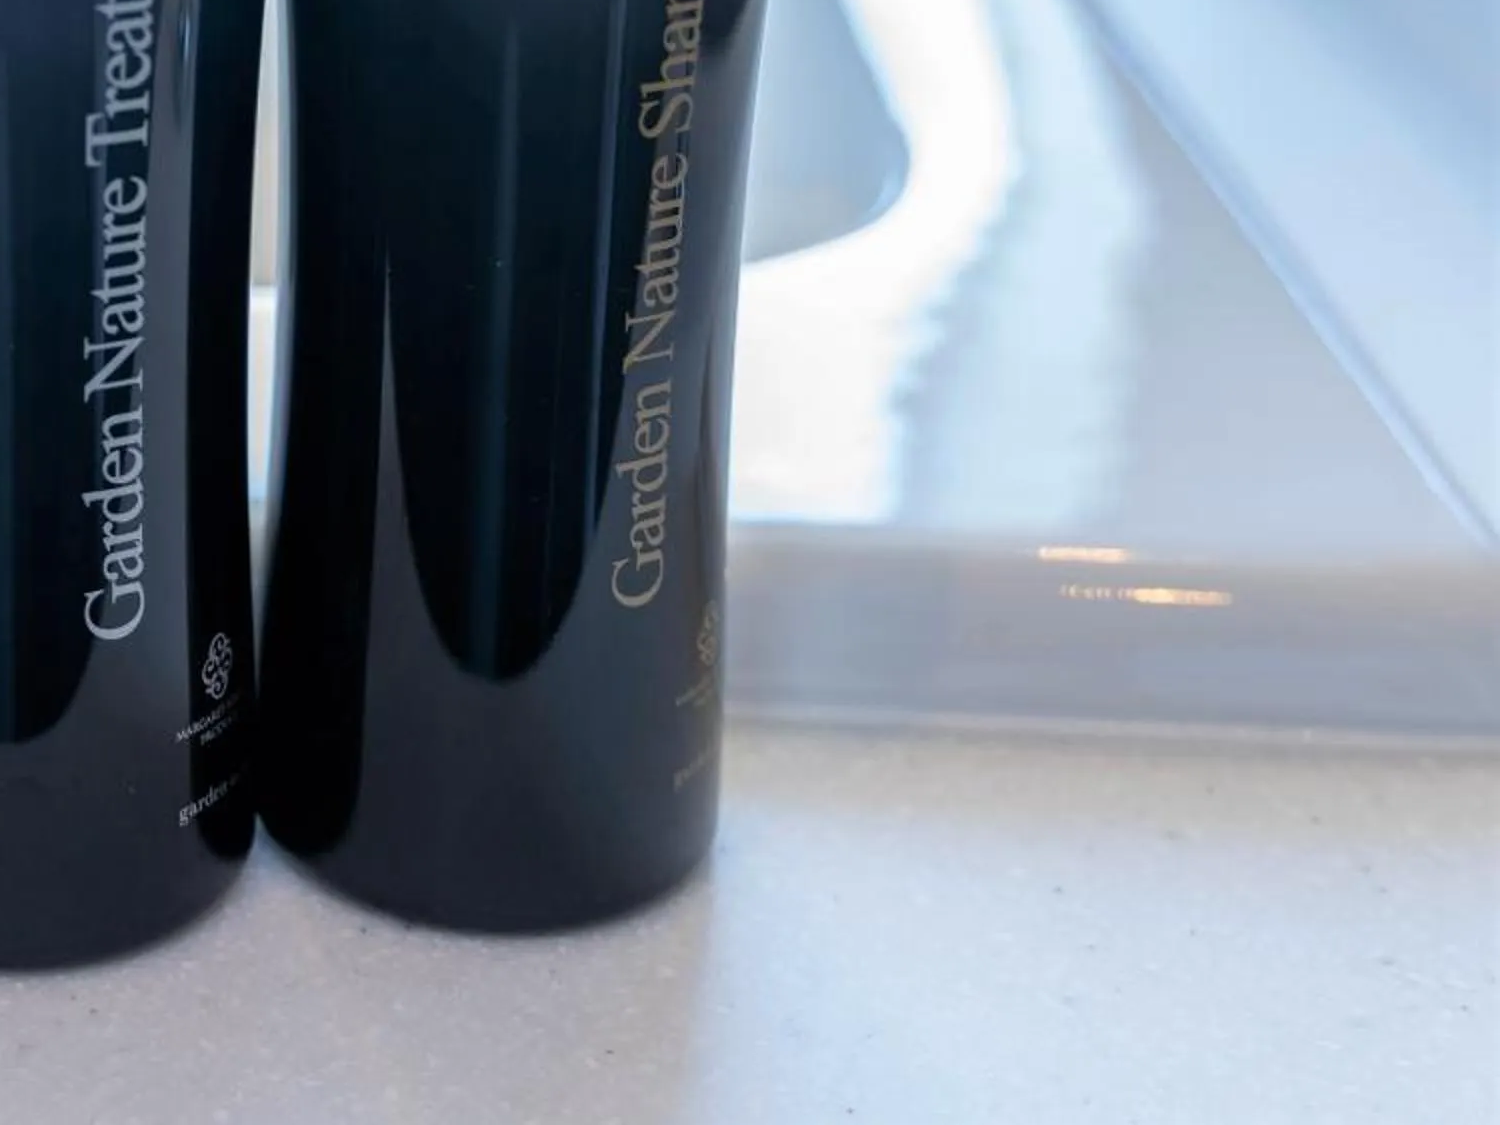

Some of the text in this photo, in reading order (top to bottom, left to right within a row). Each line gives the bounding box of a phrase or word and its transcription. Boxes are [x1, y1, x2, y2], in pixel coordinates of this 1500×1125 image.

[83, 174, 148, 403] Nature
[622, 152, 689, 375] Nature
[82, 403, 145, 641] Garden
[611, 379, 672, 607] Garden
